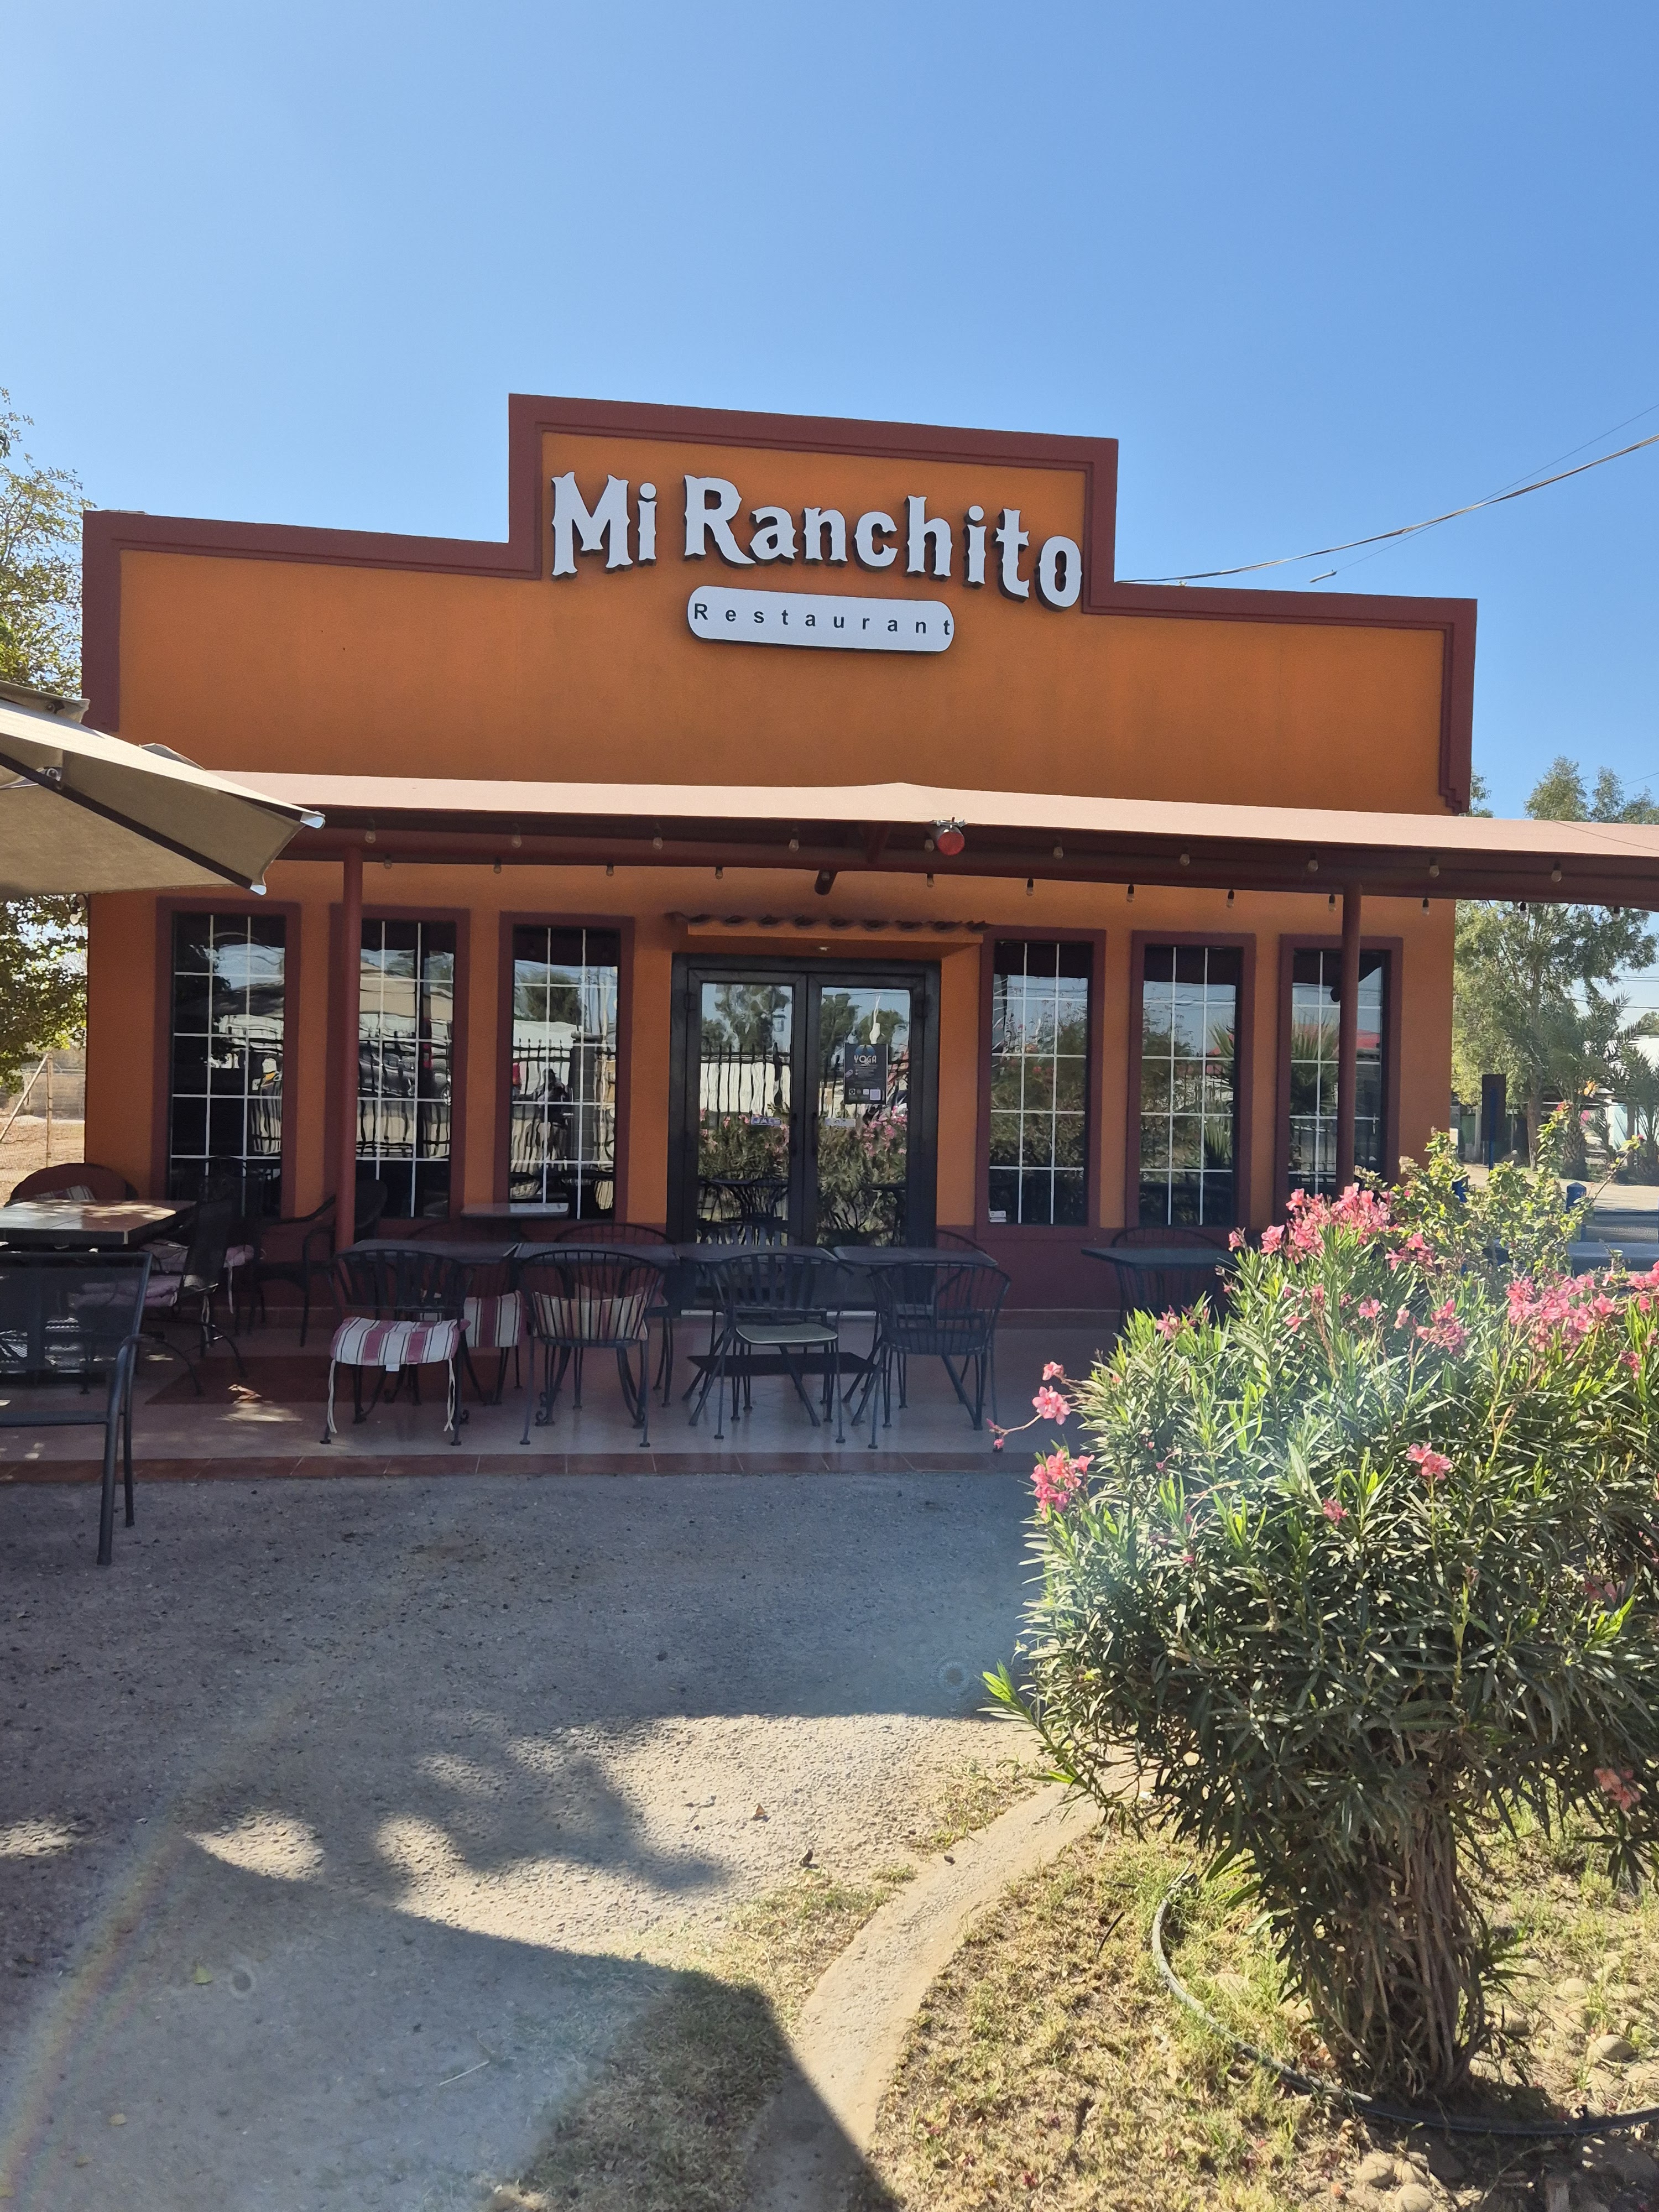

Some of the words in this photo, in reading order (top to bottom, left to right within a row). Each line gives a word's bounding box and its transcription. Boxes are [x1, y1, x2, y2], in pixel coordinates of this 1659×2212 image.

[551, 471, 657, 577] Mi
[683, 474, 1082, 609] Ranchito
[693, 602, 951, 636] Restaurant
[853, 1055, 877, 1063] YOGA
